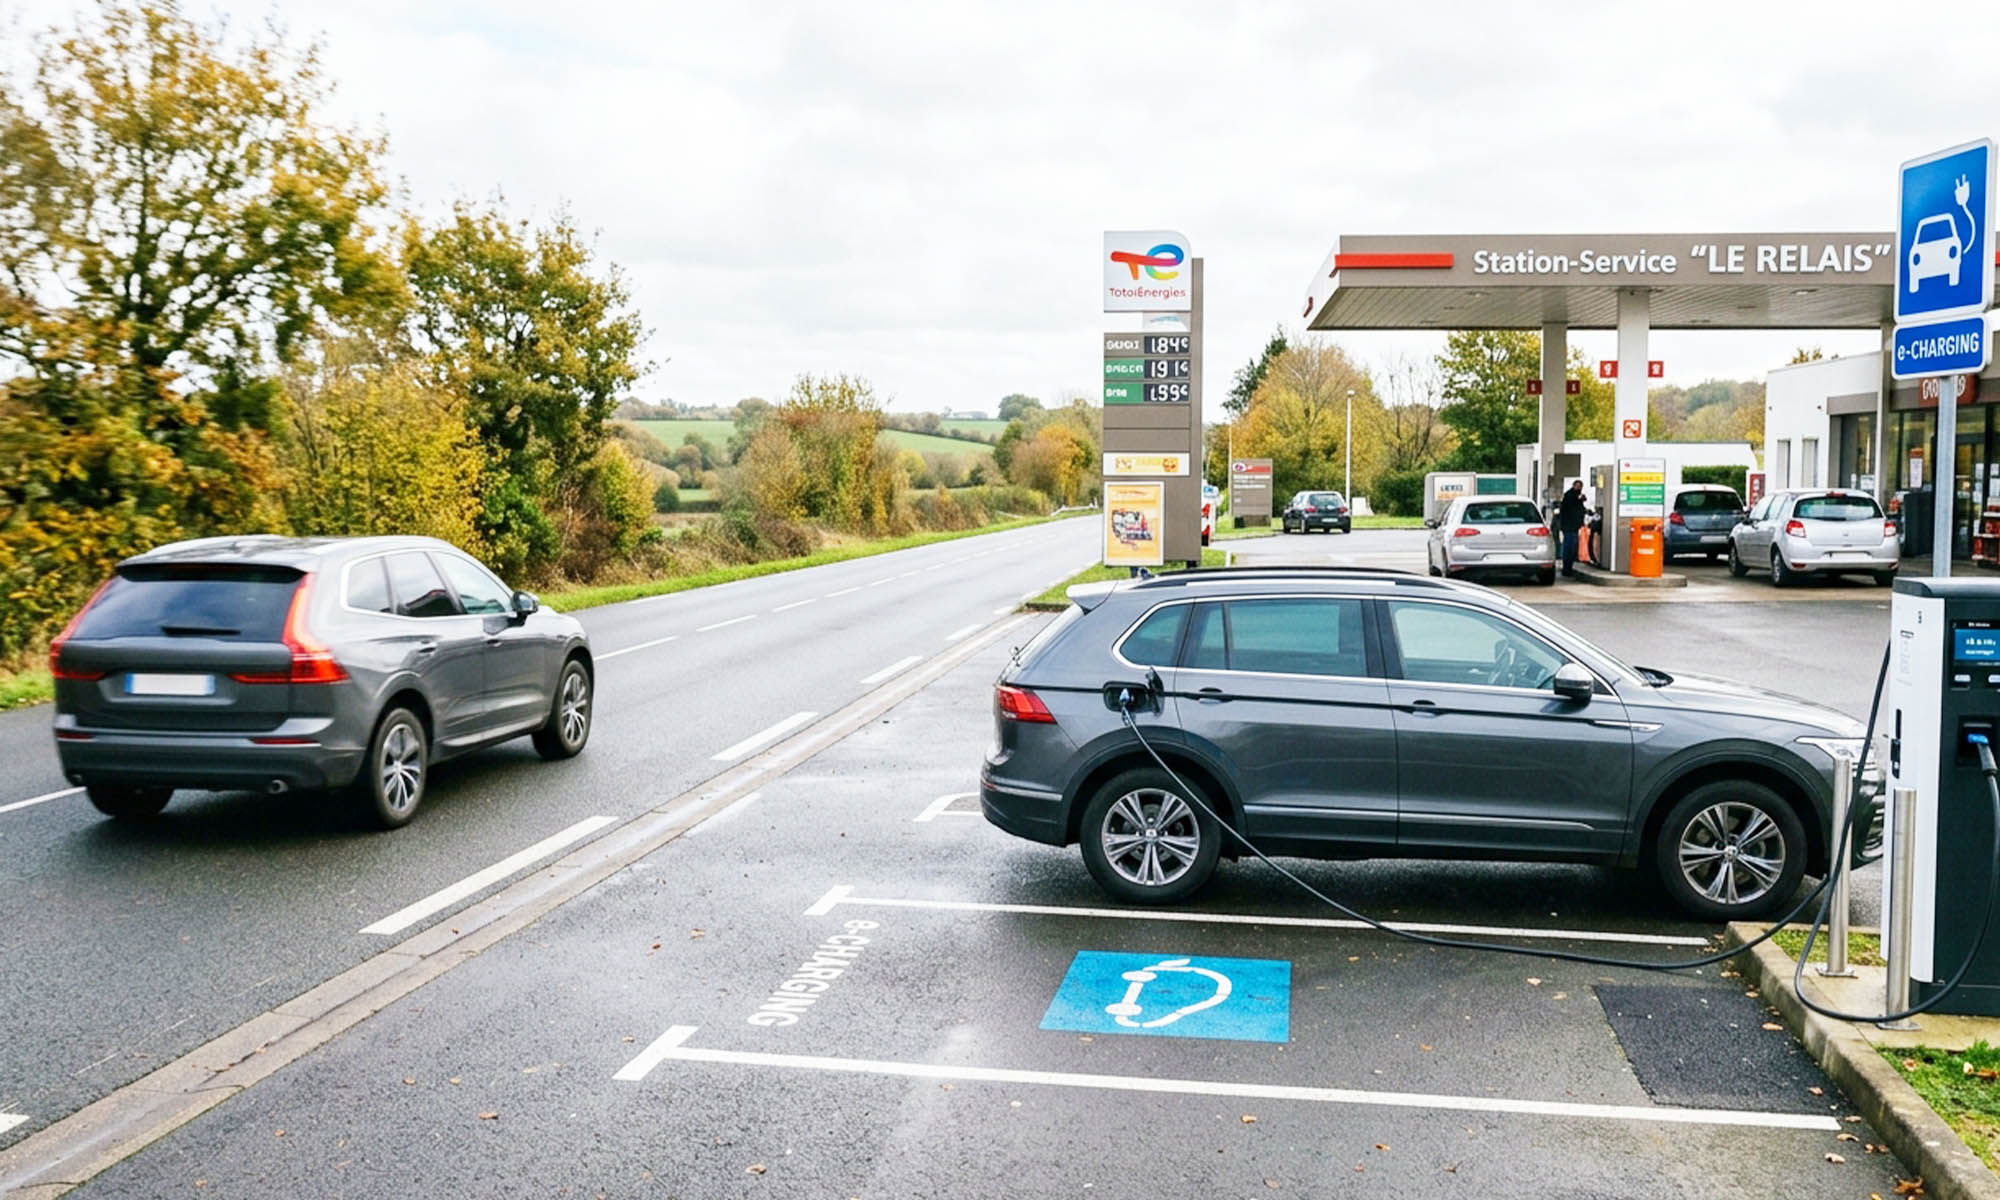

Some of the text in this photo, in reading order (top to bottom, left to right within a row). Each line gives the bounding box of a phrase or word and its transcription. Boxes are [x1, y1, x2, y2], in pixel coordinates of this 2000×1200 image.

[1473, 249, 1677, 274] Station-Service
[1897, 332, 1979, 360] e-CHARGING
[747, 919, 881, 1026] e-CHARGING
